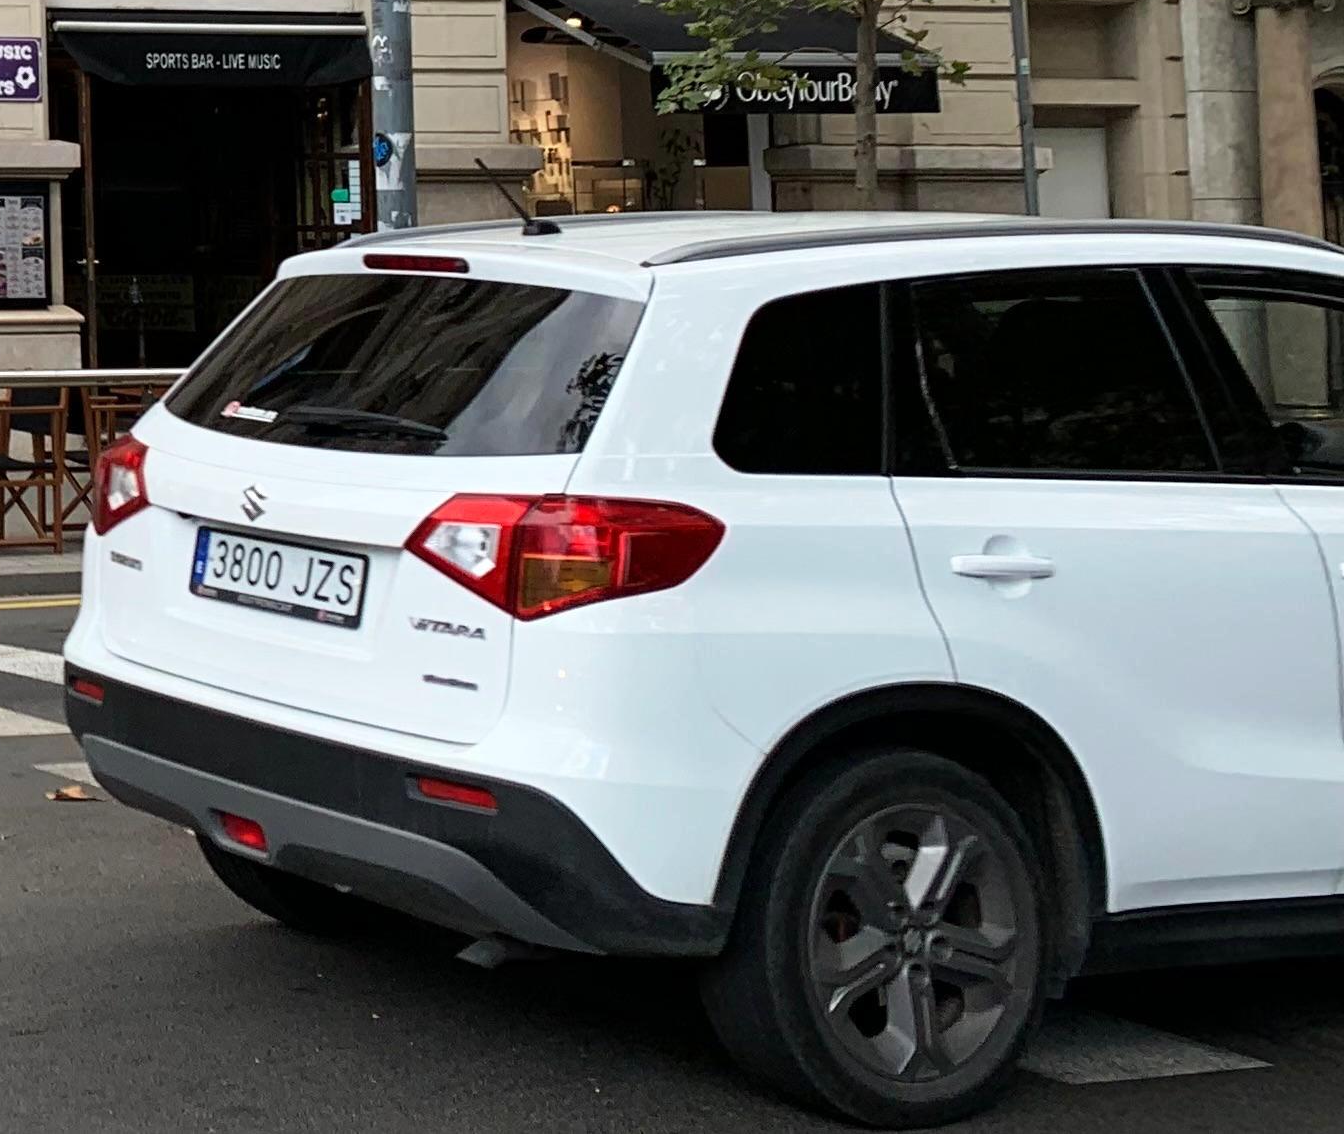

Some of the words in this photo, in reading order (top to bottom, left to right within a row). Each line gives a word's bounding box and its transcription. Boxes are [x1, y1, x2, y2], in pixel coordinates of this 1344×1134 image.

[145, 52, 190, 70] SPORTS
[191, 53, 214, 70] BAR
[222, 53, 246, 69] LIVE
[248, 54, 281, 70] MUSIC
[213, 541, 283, 591] 3800
[293, 557, 356, 606] JZS
